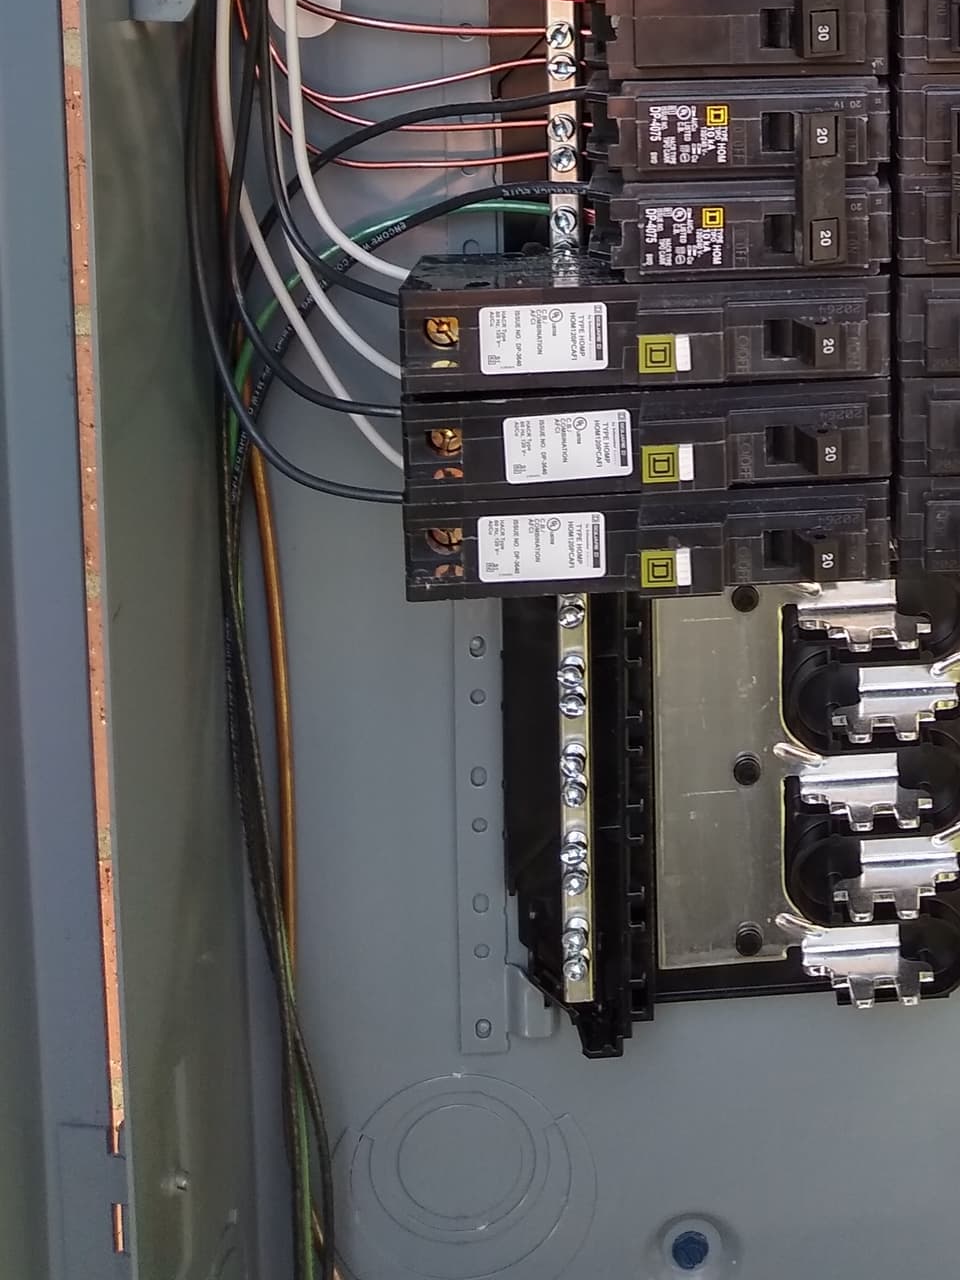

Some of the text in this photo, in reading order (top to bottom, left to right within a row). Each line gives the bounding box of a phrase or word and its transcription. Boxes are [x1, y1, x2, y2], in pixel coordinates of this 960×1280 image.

[818, 25, 830, 41] 30
[649, 106, 661, 141] DP-4075
[817, 128, 828, 144] 20
[717, 143, 726, 162] HOM
[645, 209, 657, 243] DP-4075
[820, 230, 831, 246] 20
[712, 245, 721, 264] HOM
[822, 338, 834, 354] 20
[824, 446, 836, 462] 20
[822, 553, 833, 569] 20
